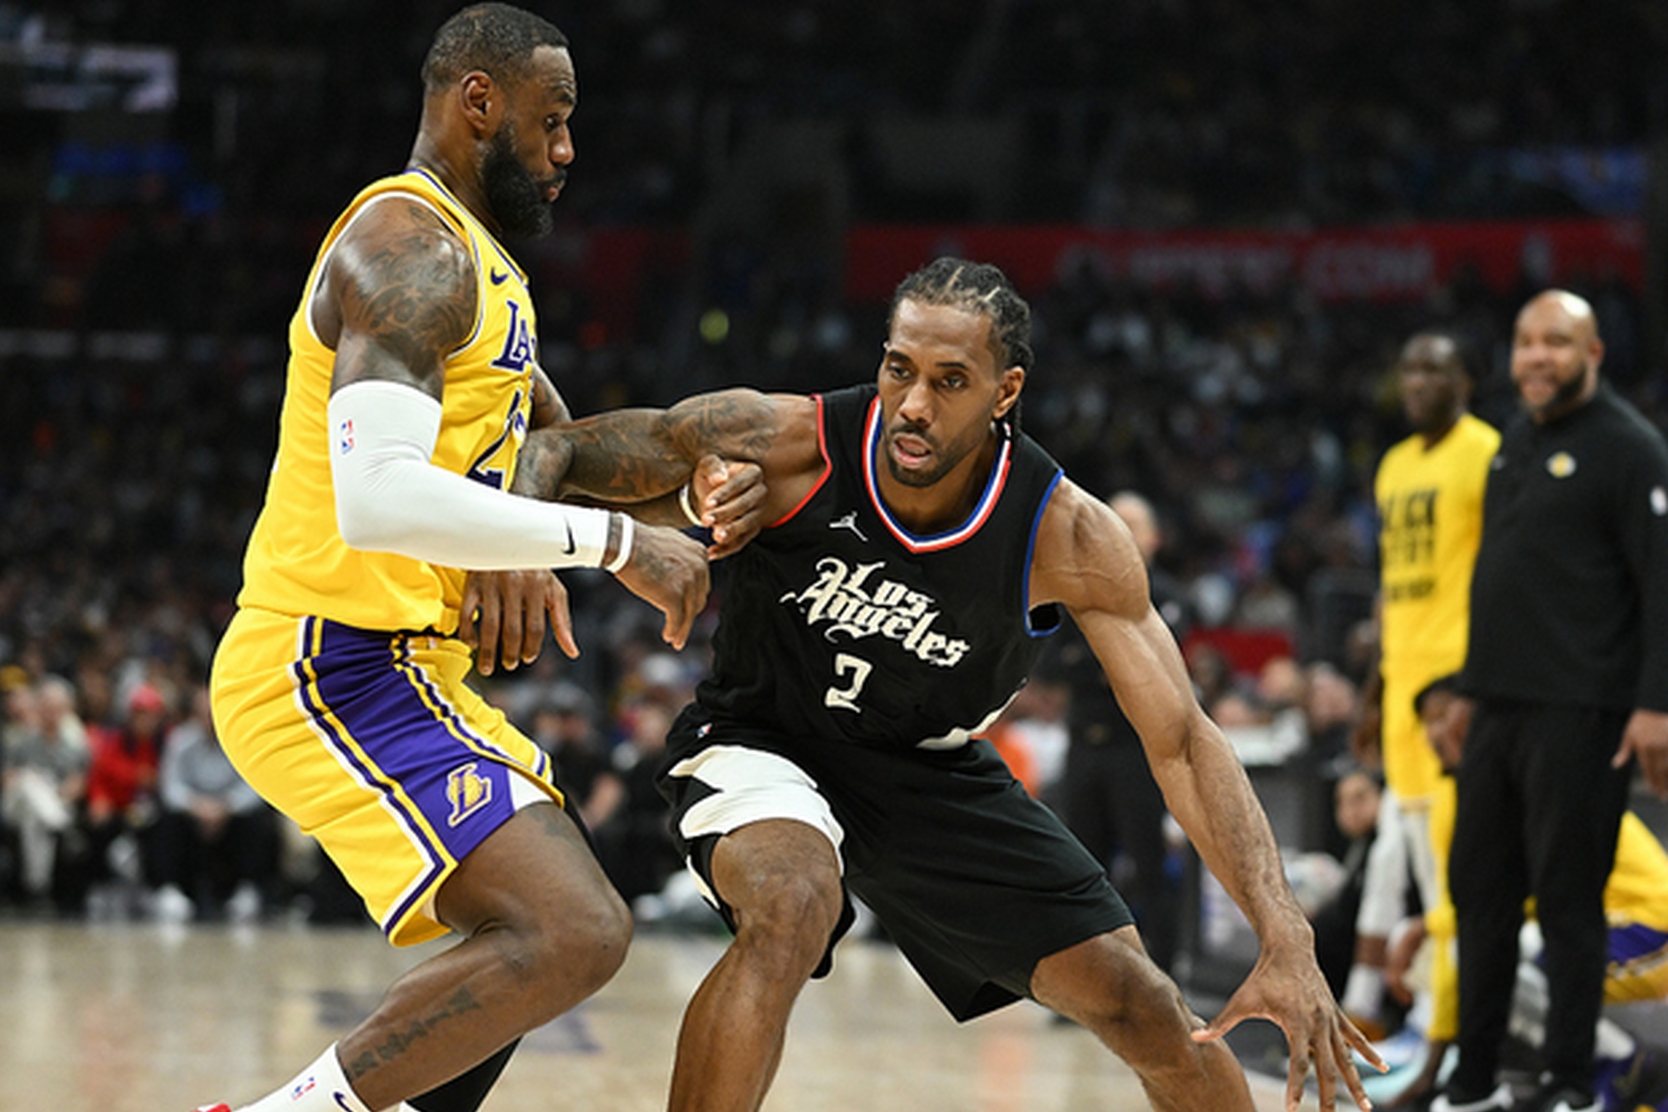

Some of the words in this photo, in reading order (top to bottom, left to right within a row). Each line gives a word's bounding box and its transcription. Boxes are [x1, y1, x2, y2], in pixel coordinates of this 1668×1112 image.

[779, 557, 971, 667] Angeles
[841, 561, 936, 619] Los
[825, 653, 873, 713] 2
